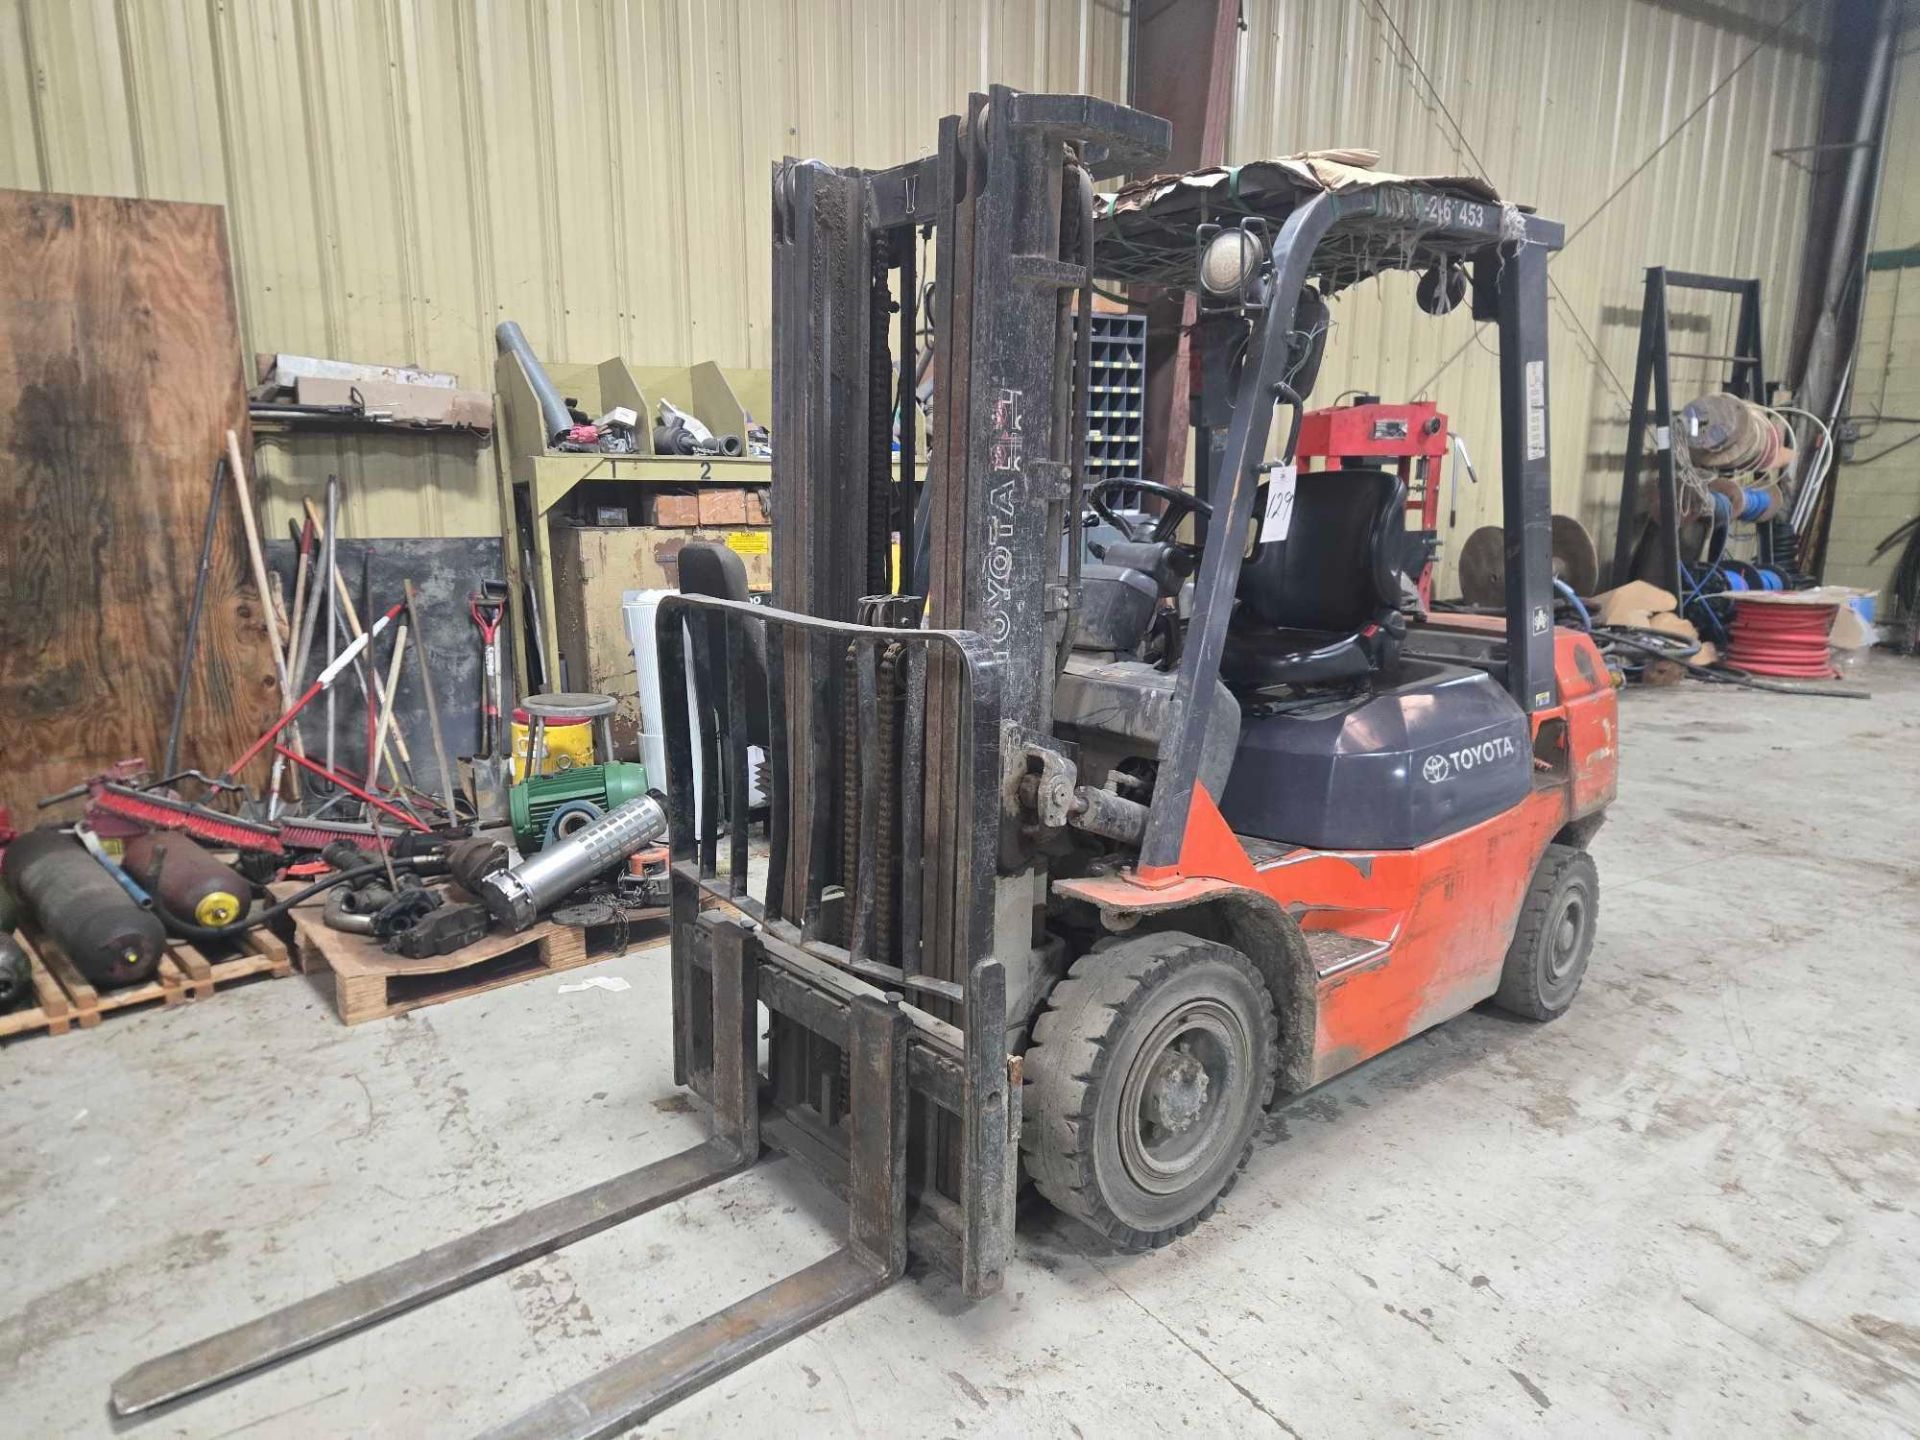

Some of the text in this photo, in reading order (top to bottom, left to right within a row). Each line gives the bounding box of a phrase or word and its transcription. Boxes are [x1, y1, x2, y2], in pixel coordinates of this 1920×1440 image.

[1459, 203, 1484, 227] 453
[700, 461, 712, 480] 2
[1449, 736, 1515, 772] TOYOTA
